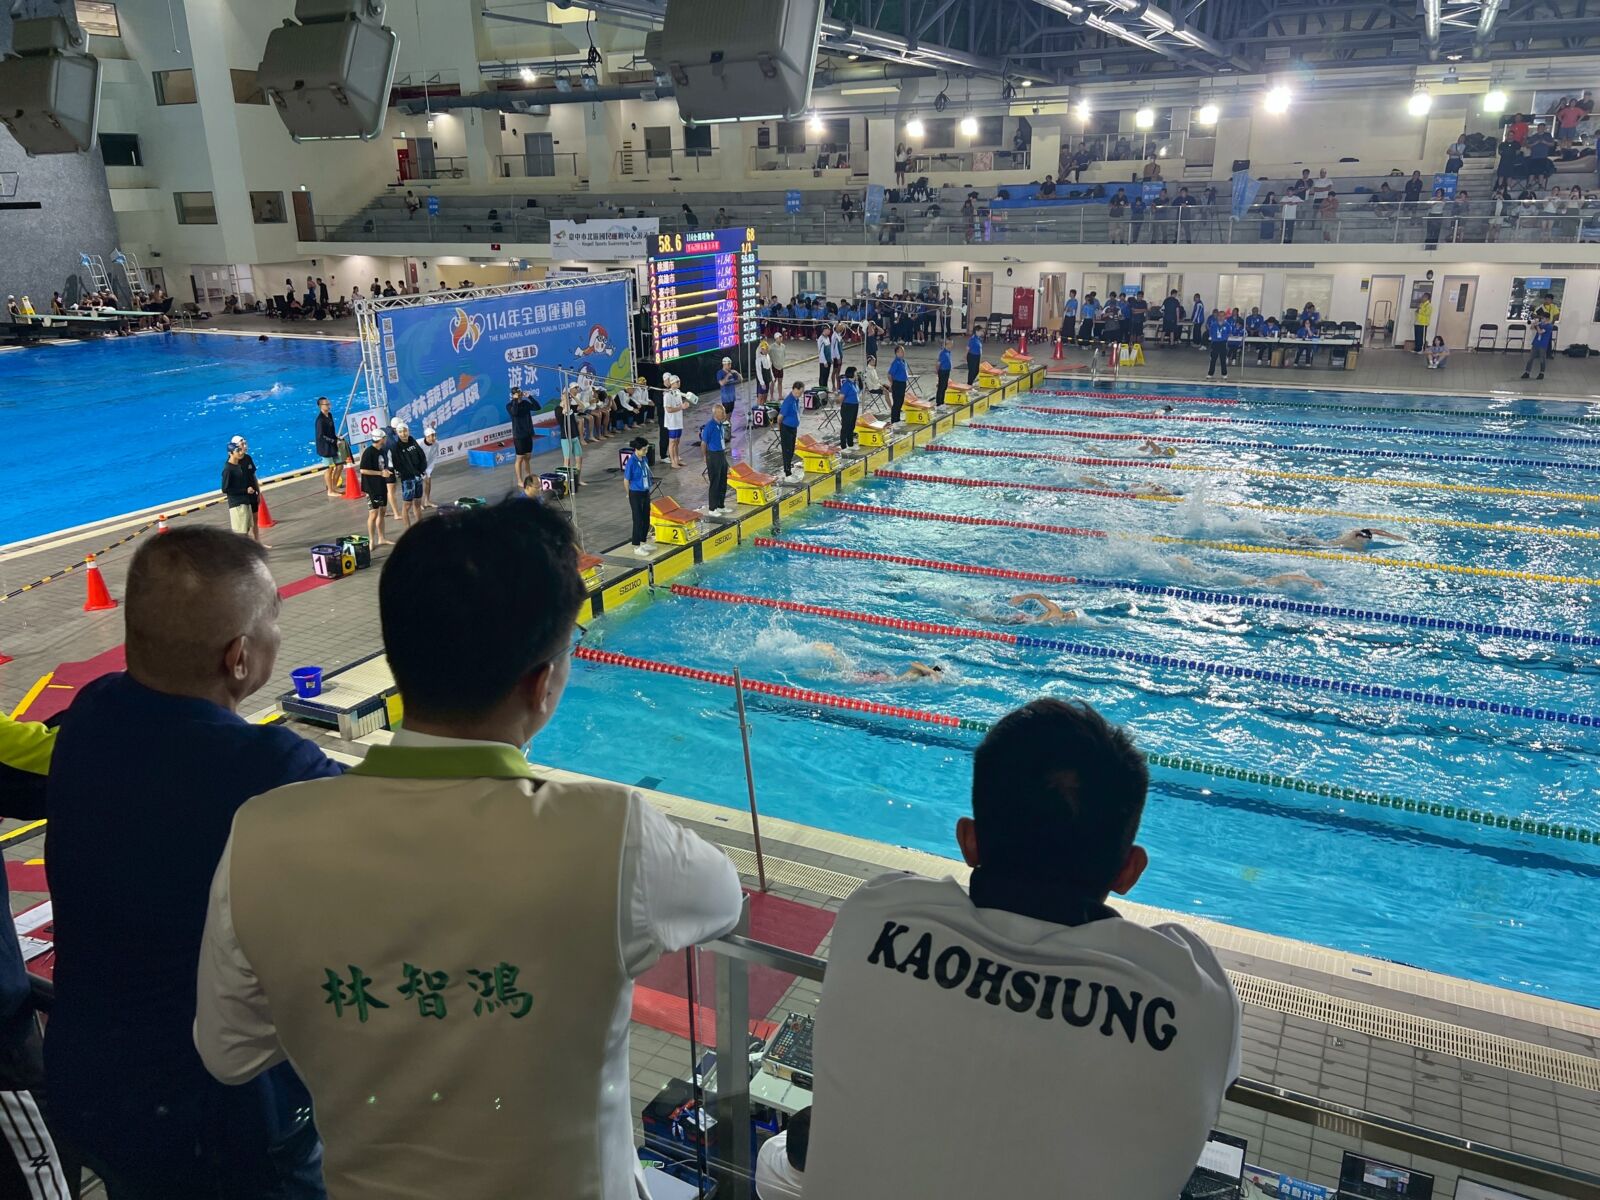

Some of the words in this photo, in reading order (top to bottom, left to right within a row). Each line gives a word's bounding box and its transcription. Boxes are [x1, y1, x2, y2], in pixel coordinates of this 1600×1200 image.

[746, 227, 755, 241] 68
[658, 234, 682, 253] 58.6
[741, 242, 752, 253] 1/1
[650, 264, 655, 274] 1
[650, 276, 656, 288] 2
[651, 289, 657, 300] 3
[652, 303, 657, 312] 4
[486, 300, 586, 331] 114年全國運動會
[653, 315, 658, 325] 5
[500, 330, 523, 341] NATIONAL
[524, 328, 540, 336] GAMES
[541, 325, 557, 333] YUNLIN
[558, 322, 575, 330] COUNTY
[653, 327, 659, 338] 6
[654, 340, 659, 351] 7
[507, 347, 537, 361] 水上運動
[656, 352, 660, 363] 8
[508, 365, 538, 388] 游泳
[805, 395, 812, 407] 7
[755, 411, 763, 424] 6
[918, 412, 923, 421] 6
[360, 415, 378, 434] 68
[872, 434, 877, 443] 5
[818, 460, 824, 468] 4
[753, 490, 759, 500] 3
[672, 529, 679, 539] 2
[714, 532, 733, 547] SEIKO
[315, 555, 324, 575] 1
[619, 578, 642, 597] SEIKO
[867, 920, 1178, 1051] KAOHSIUNG
[321, 961, 535, 1023] 林智鴻
